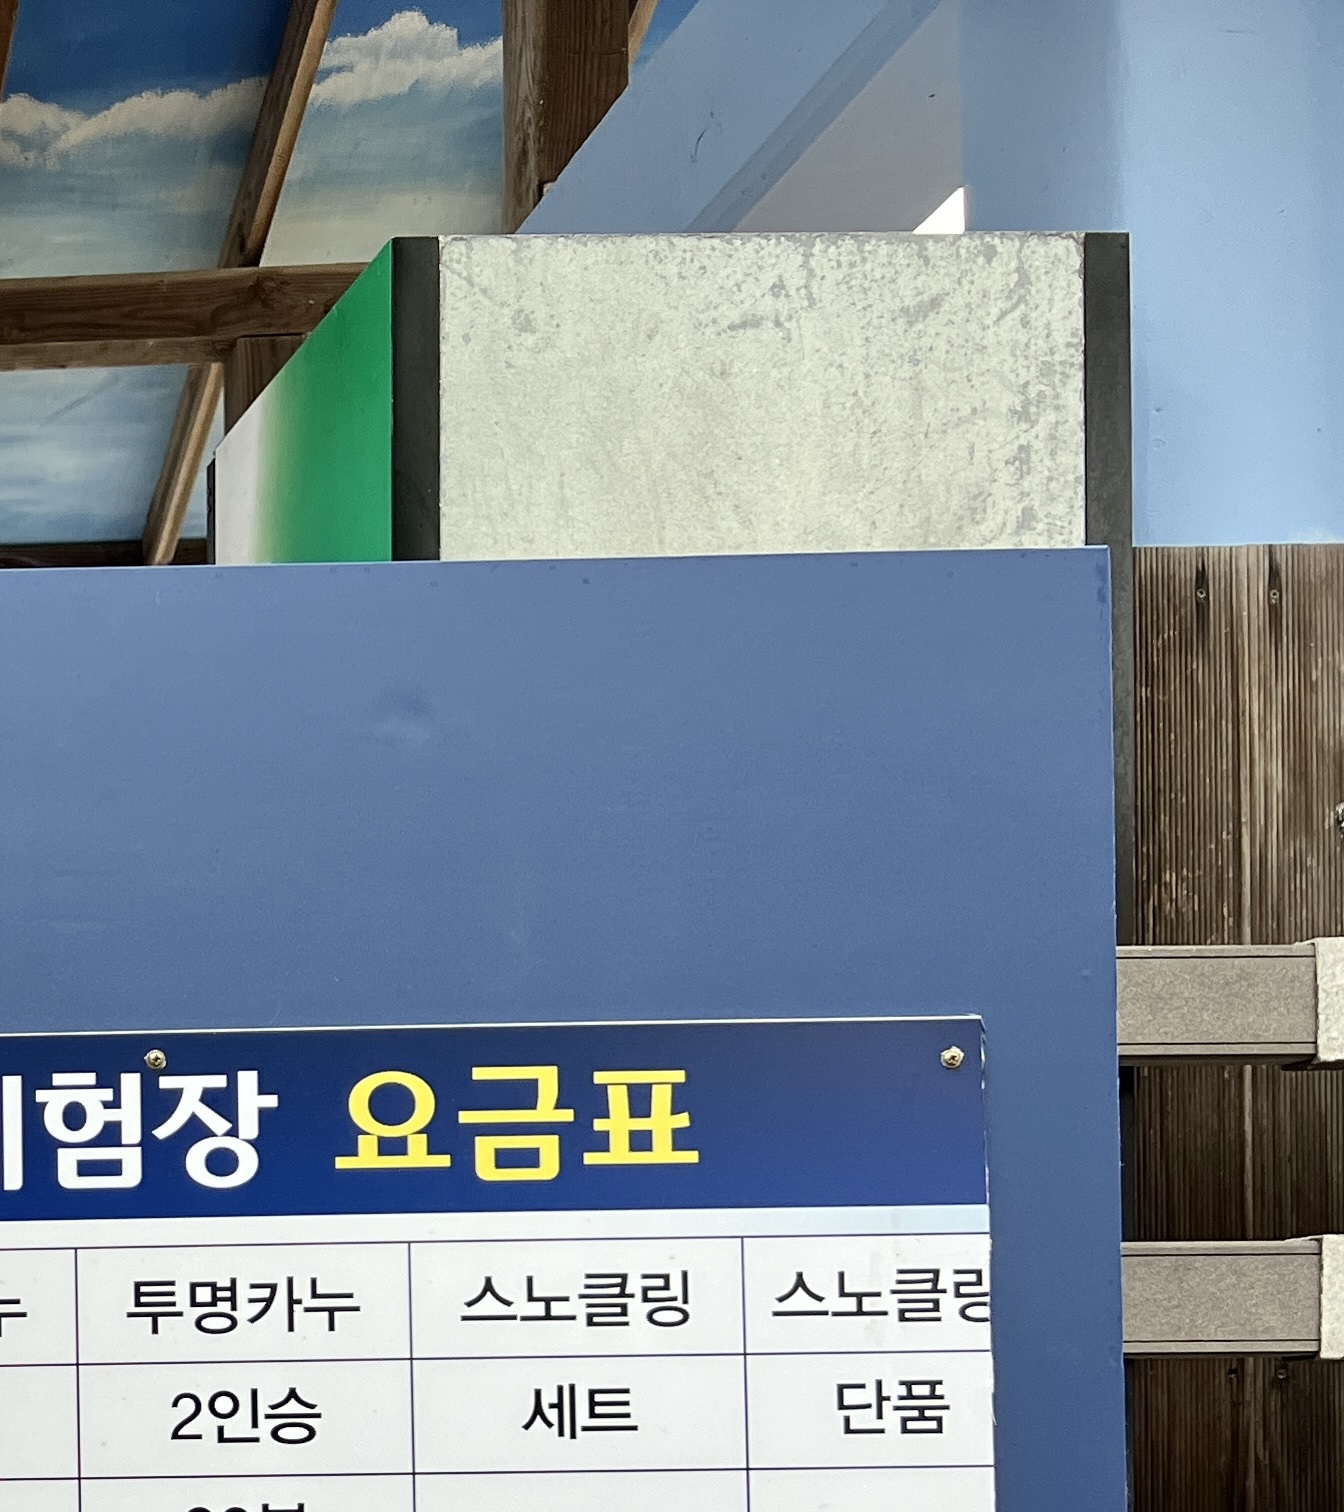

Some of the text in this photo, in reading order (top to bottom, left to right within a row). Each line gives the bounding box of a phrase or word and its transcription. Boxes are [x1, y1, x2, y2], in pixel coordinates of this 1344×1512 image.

[334, 1065, 701, 1183] 요금표
[125, 1276, 362, 1336] 투명카누
[460, 1269, 692, 1329] 스노클링
[171, 1385, 323, 1447] 2인승
[521, 1383, 639, 1441] 세트
[835, 1378, 952, 1437] 단품
